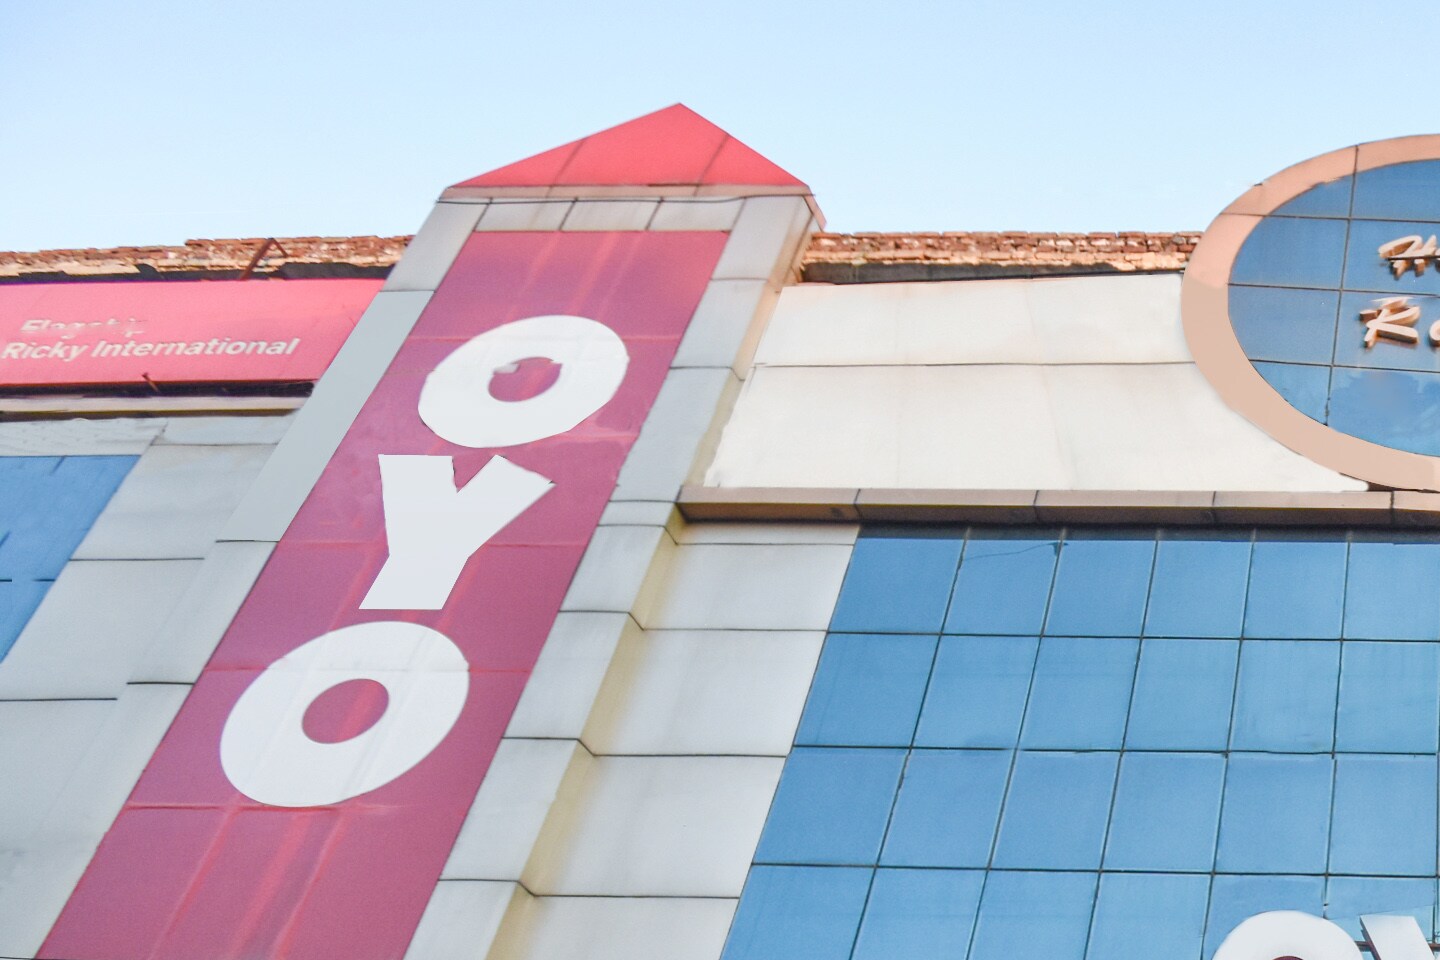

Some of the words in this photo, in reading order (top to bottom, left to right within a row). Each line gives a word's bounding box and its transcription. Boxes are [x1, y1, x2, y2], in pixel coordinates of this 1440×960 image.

[1, 340, 89, 362] Ricky
[91, 336, 300, 358] International
[219, 314, 630, 808] OYO
